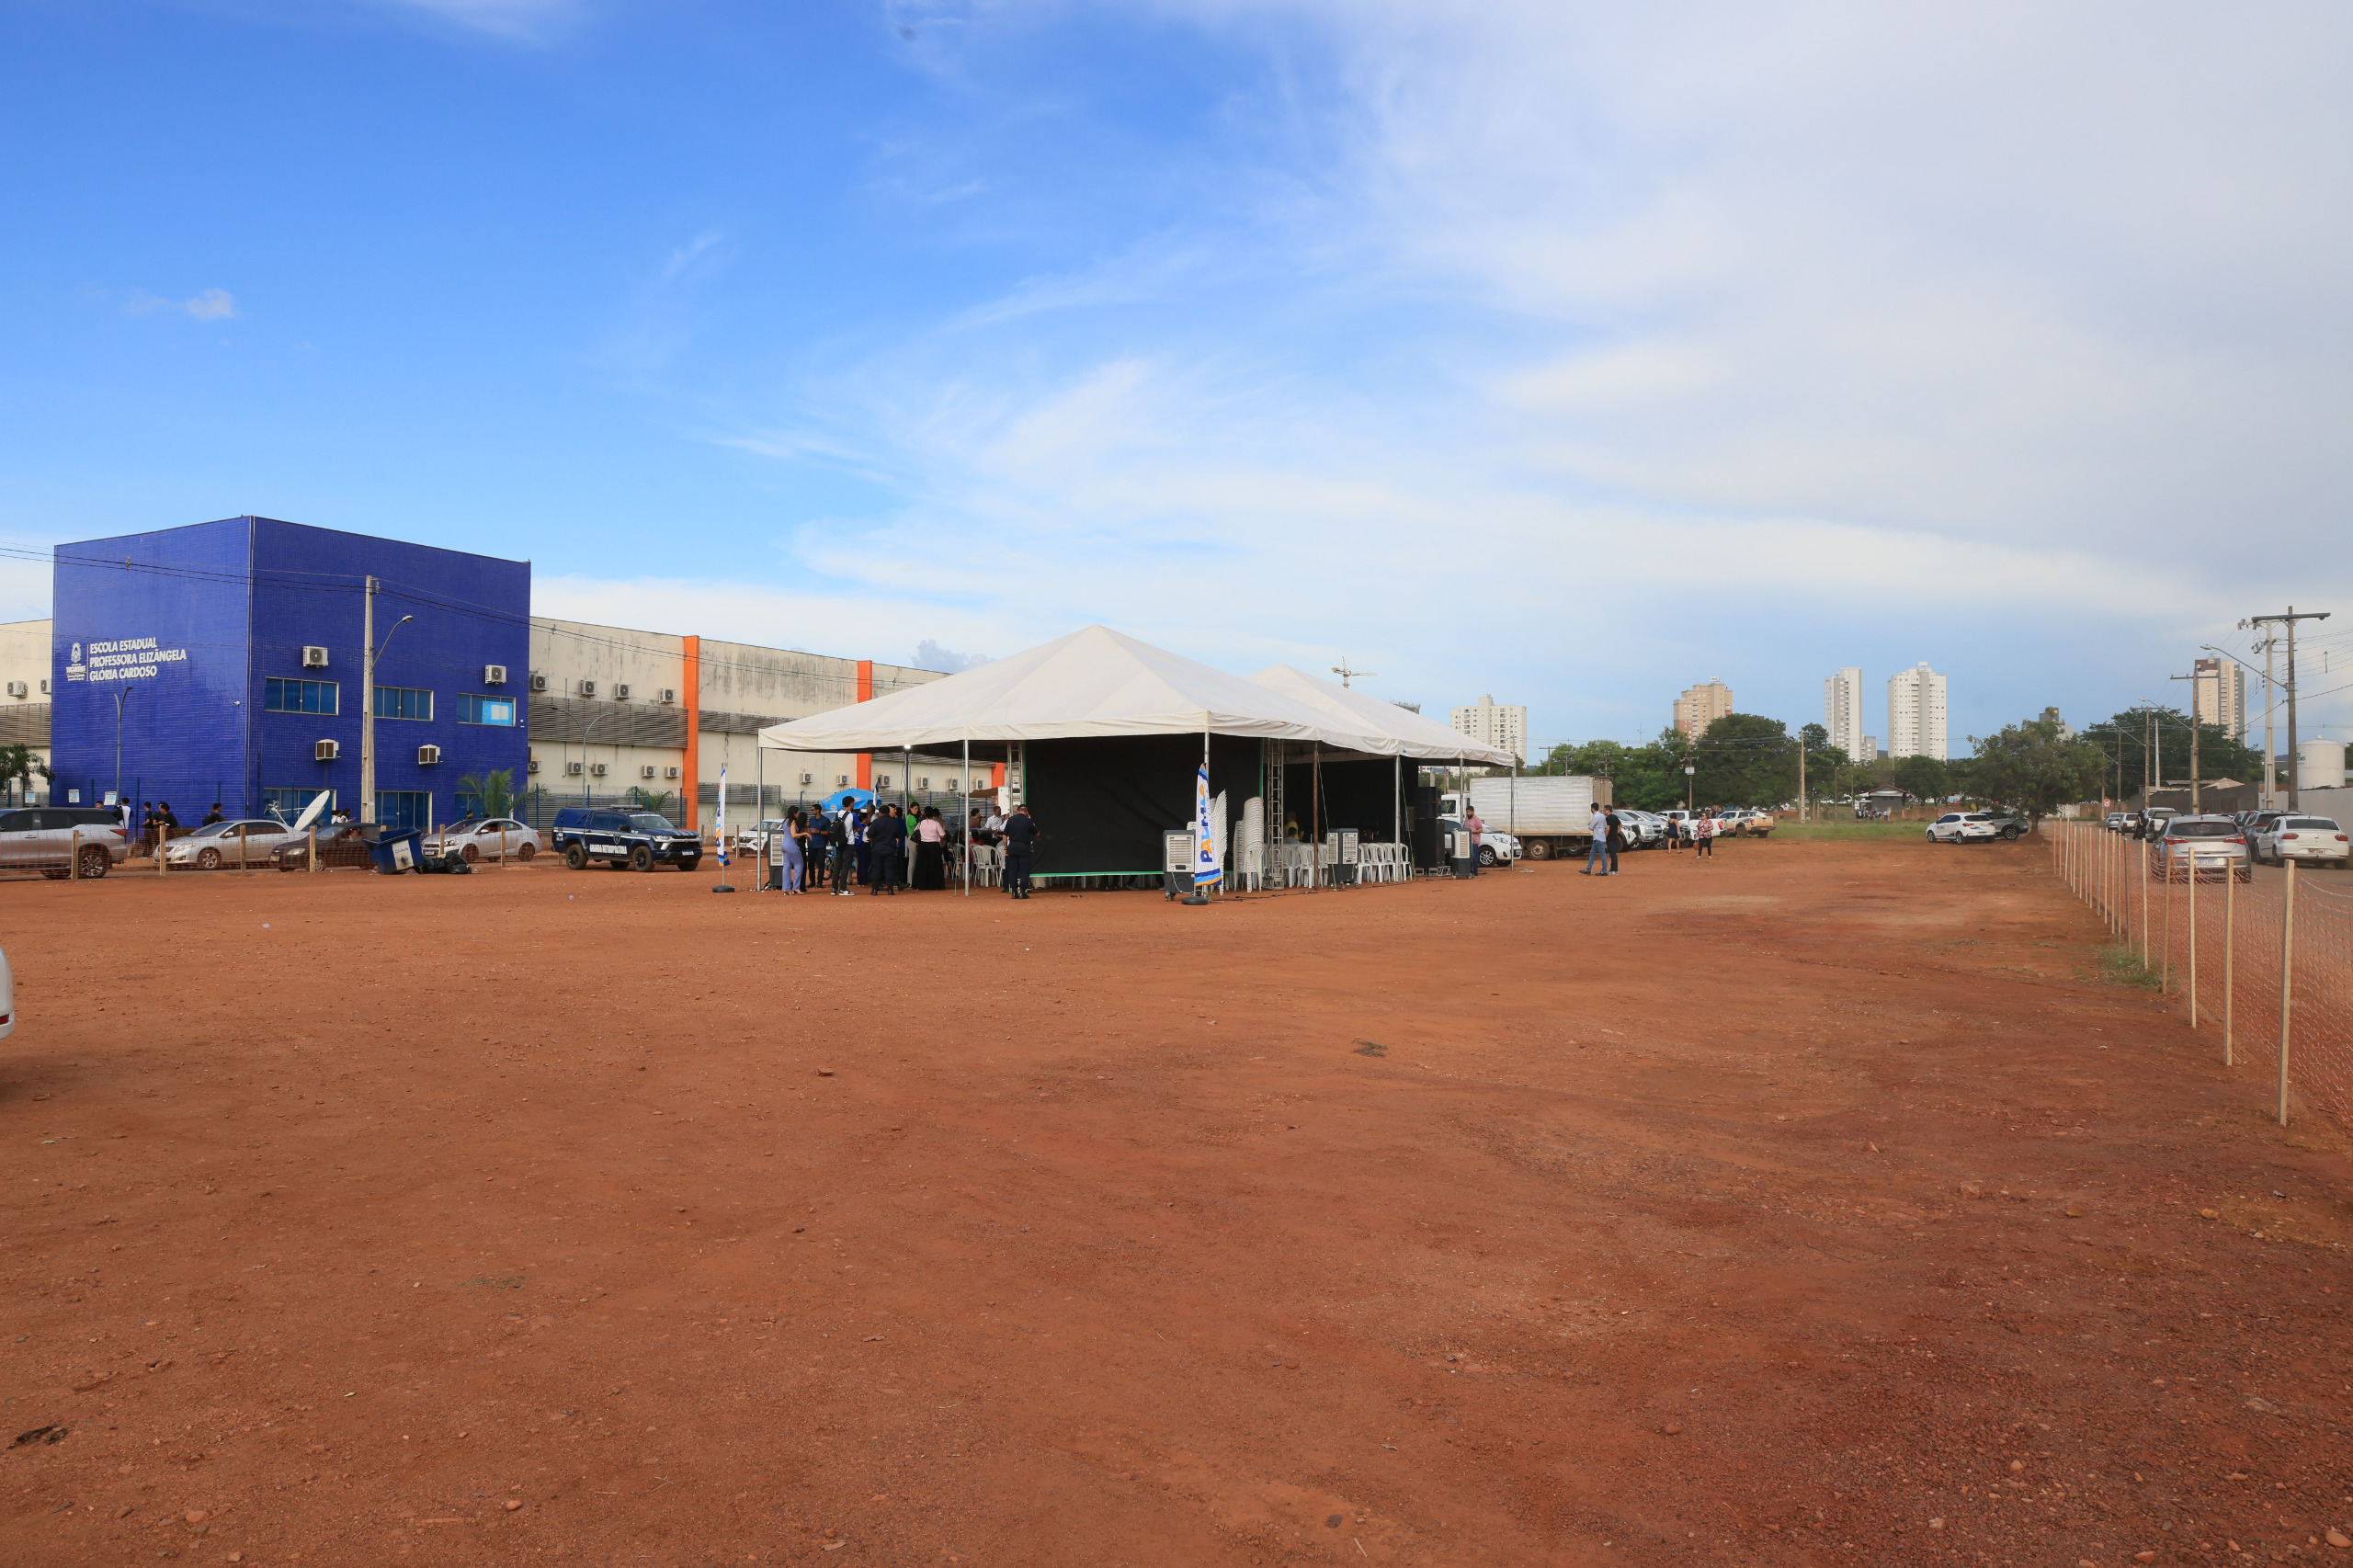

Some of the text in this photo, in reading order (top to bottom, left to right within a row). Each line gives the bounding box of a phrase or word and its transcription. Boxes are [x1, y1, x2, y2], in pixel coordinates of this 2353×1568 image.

[90, 637, 157, 654] ESCOLA ESTADUAL
[90, 648, 187, 668] PROFESSORA ELIZÂNGELA
[90, 665, 157, 681] GLÓRIA CARDOSO
